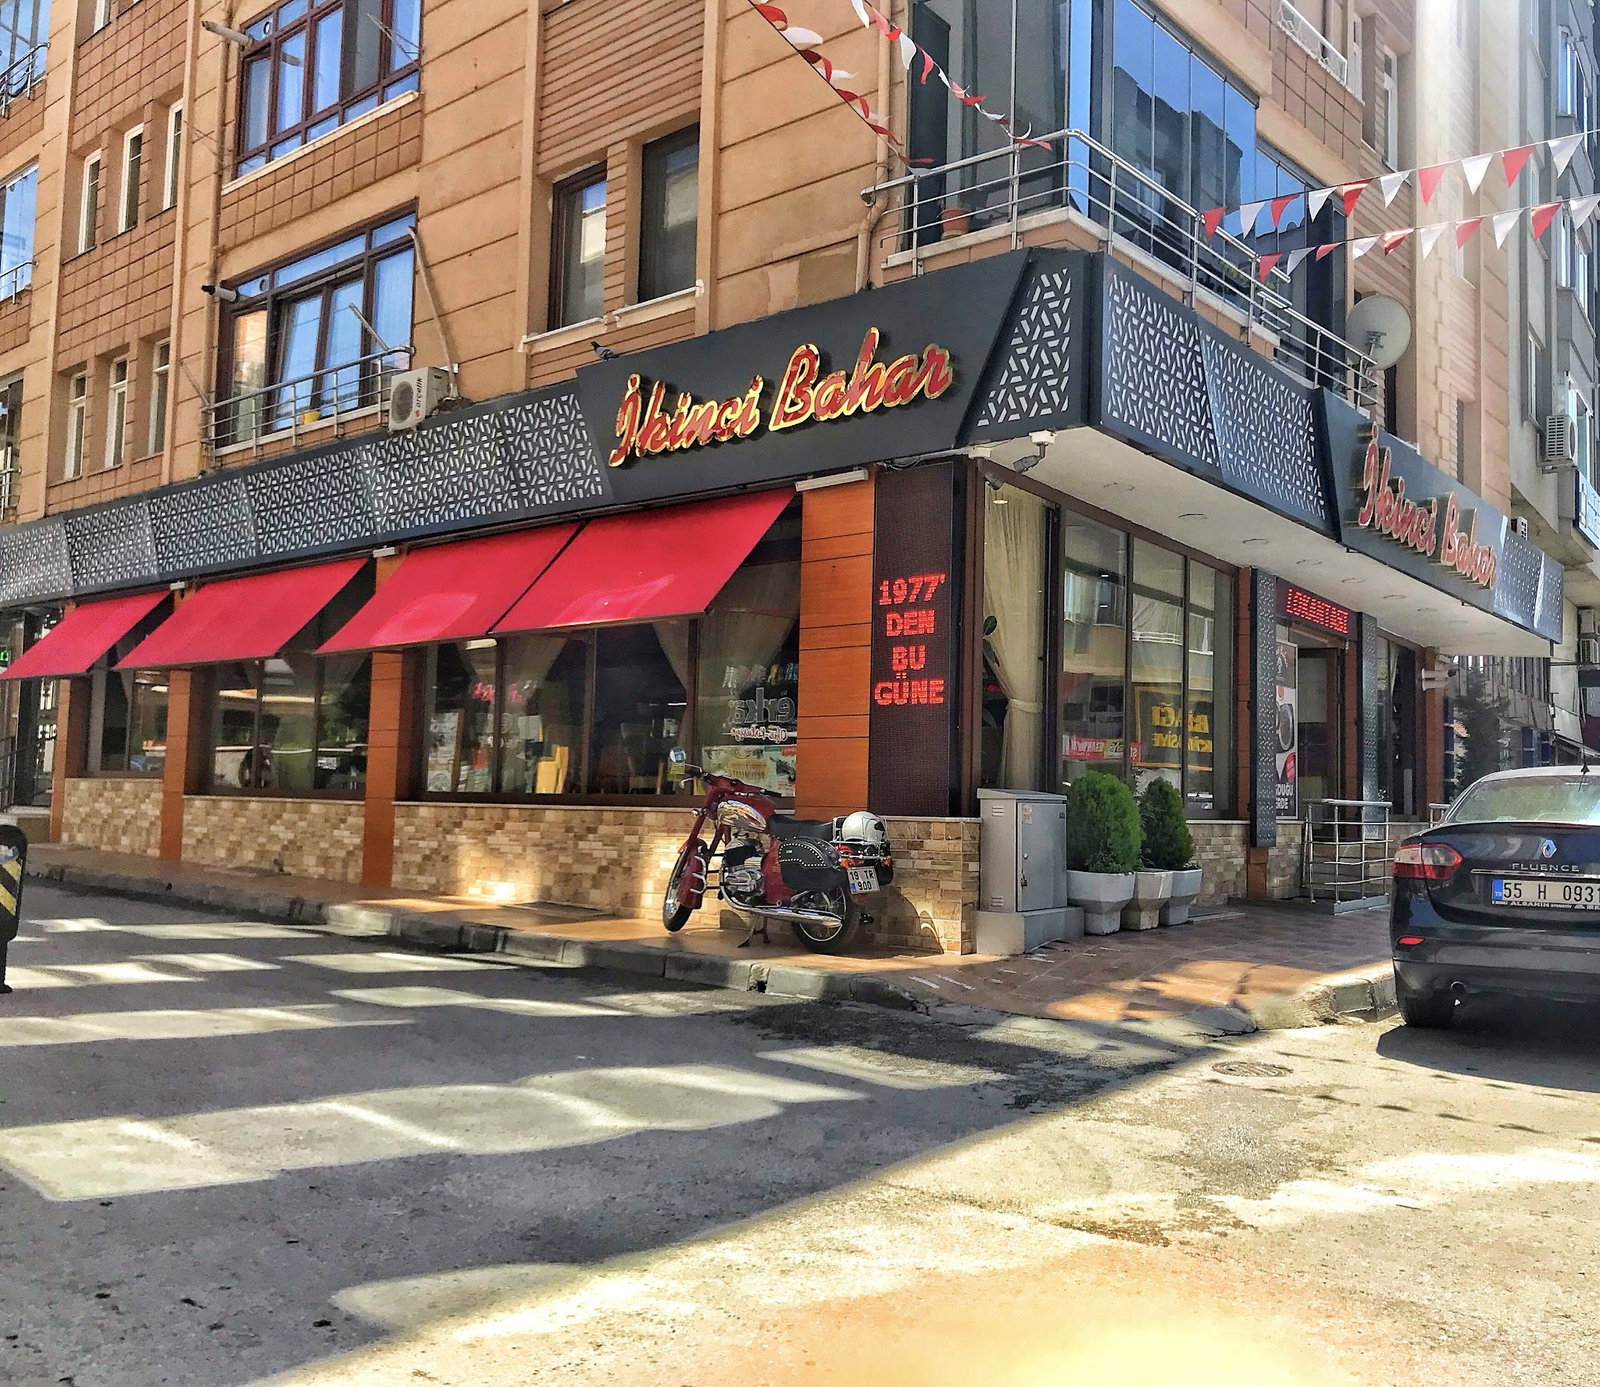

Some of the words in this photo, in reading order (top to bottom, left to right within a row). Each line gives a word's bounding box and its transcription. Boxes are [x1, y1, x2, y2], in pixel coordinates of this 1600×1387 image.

[608, 373, 764, 468] İkinci
[769, 327, 954, 432] Bahar
[1441, 492, 1498, 590] Bahar
[886, 609, 935, 636] DEN
[892, 644, 926, 671] BU
[874, 672, 944, 706] GÜNE
[850, 871, 859, 880] 19
[864, 869, 874, 880] TR
[1511, 863, 1580, 872] FLUENCE
[857, 881, 872, 891] 900
[1503, 882, 1522, 899] 55
[1537, 884, 1547, 900] H
